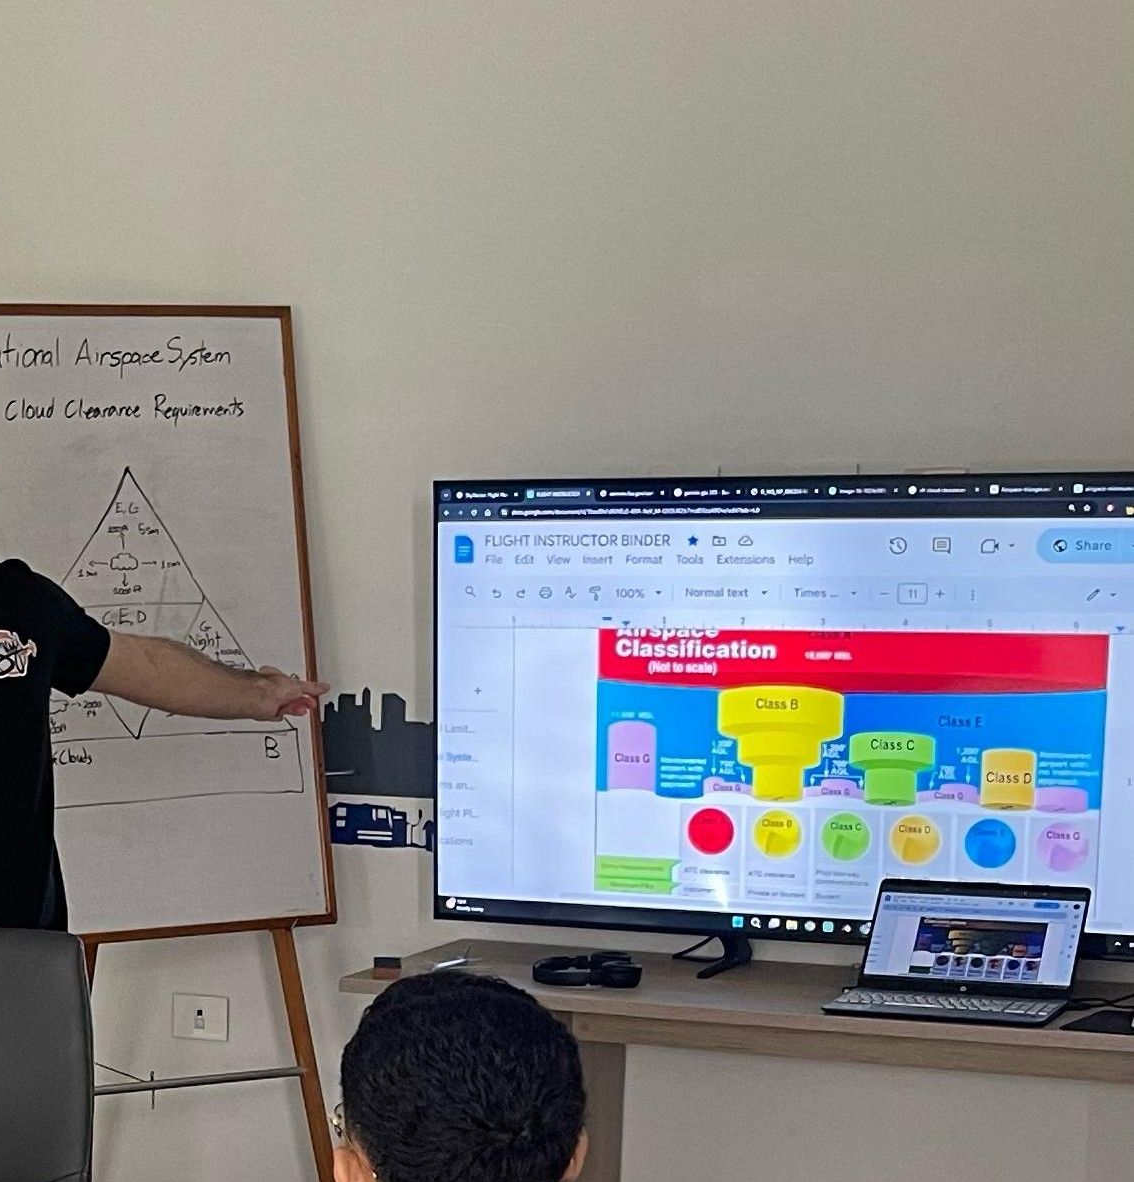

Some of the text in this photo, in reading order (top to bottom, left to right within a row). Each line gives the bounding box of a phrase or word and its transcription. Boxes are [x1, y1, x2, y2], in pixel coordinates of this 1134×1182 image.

[74, 338, 163, 379] Airspace
[166, 336, 231, 371] System
[4, 393, 245, 426] Cloud Clearance Requirements
[485, 535, 670, 548] FLIGHT INSTRUCTOR BINDER
[1075, 539, 1112, 552] Share
[485, 554, 814, 566] File Edit View Insert Format Tools Extensions Help
[615, 587, 918, 599] 100% Normal text Times 11
[615, 638, 777, 661] Classification
[648, 661, 718, 676] (Not to scale)
[756, 698, 799, 711] Class B
[938, 714, 985, 728] Class E
[265, 736, 281, 759] B
[870, 738, 916, 751] Class C
[614, 752, 641, 764] Class
[986, 771, 1032, 785] Class D
[821, 787, 841, 796] Class
[830, 821, 863, 832] Class C
[898, 824, 922, 834] Class
[1045, 830, 1070, 841] Class
